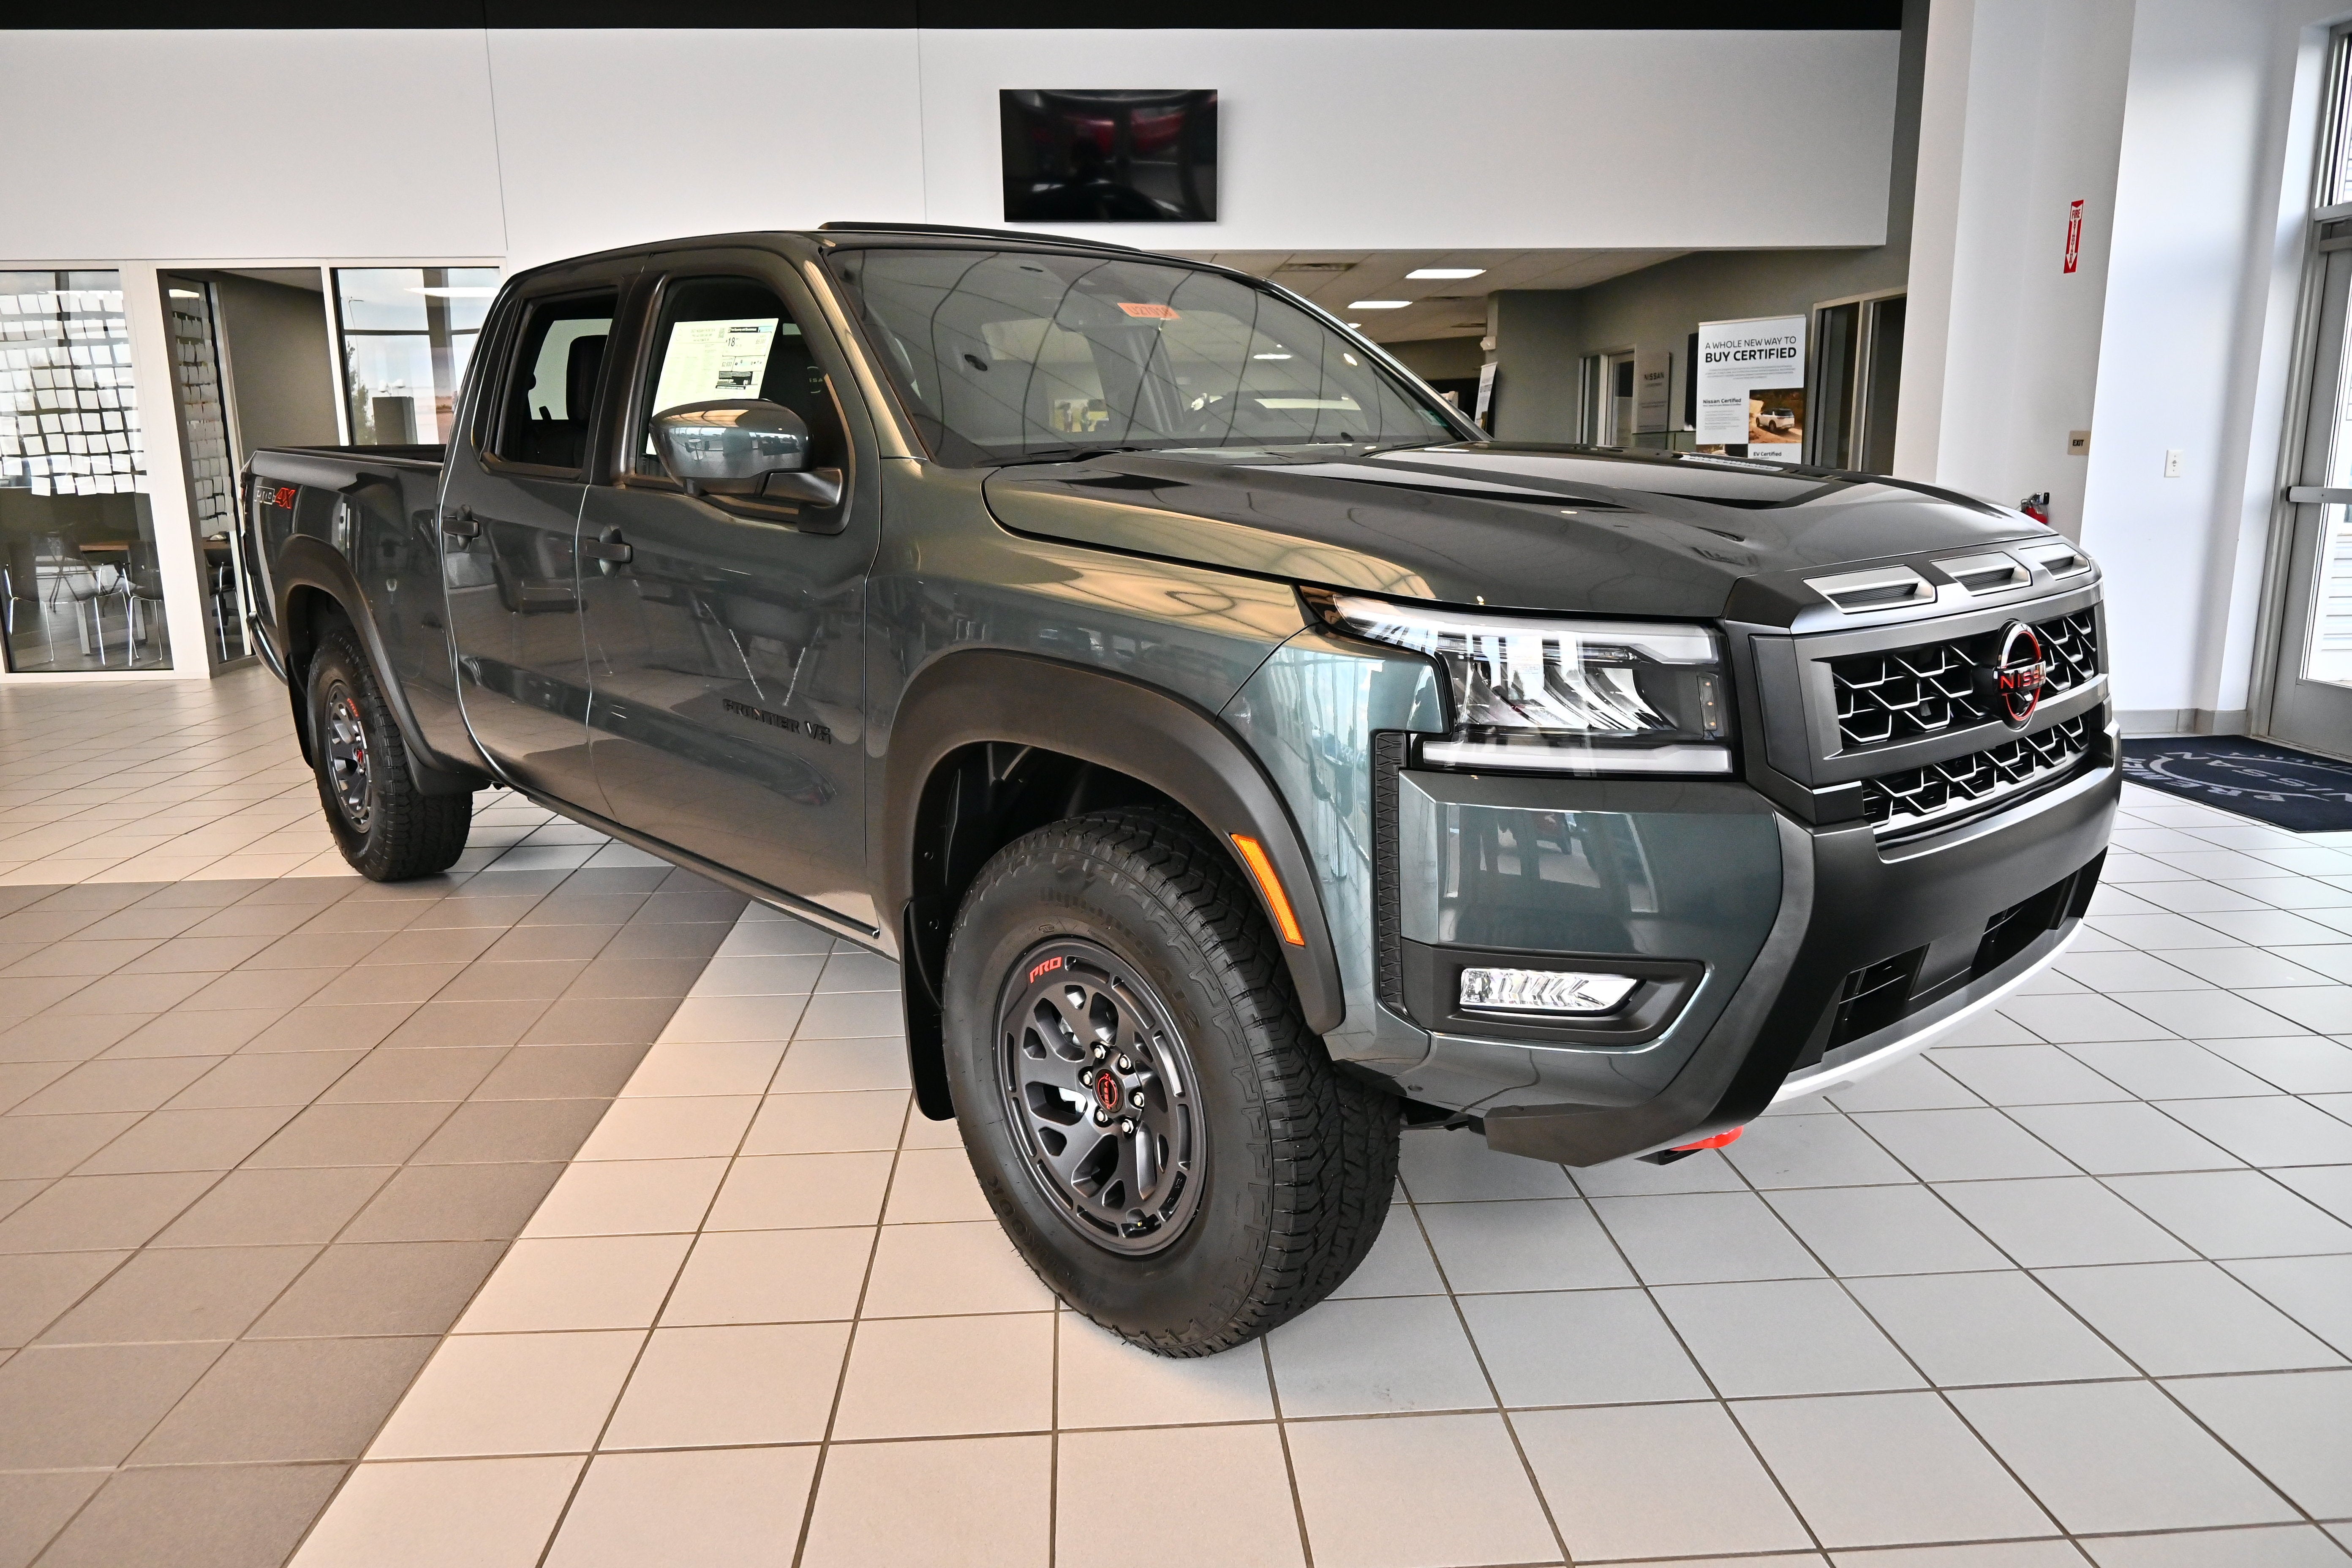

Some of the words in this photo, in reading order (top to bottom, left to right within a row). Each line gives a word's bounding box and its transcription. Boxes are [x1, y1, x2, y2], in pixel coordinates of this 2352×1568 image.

[2072, 209, 2081, 219] FIRE
[1712, 340, 1742, 349] WHOLE
[1744, 338, 1763, 347] NEW
[1764, 337, 1782, 346] WAY
[1784, 336, 1797, 344] TO
[1705, 351, 1730, 362] BUY
[1733, 347, 1797, 361] CERTIFIED
[1644, 372, 1664, 380] NISSAN
[722, 698, 800, 734] FRONTIER
[1029, 956, 1062, 984] PRO
